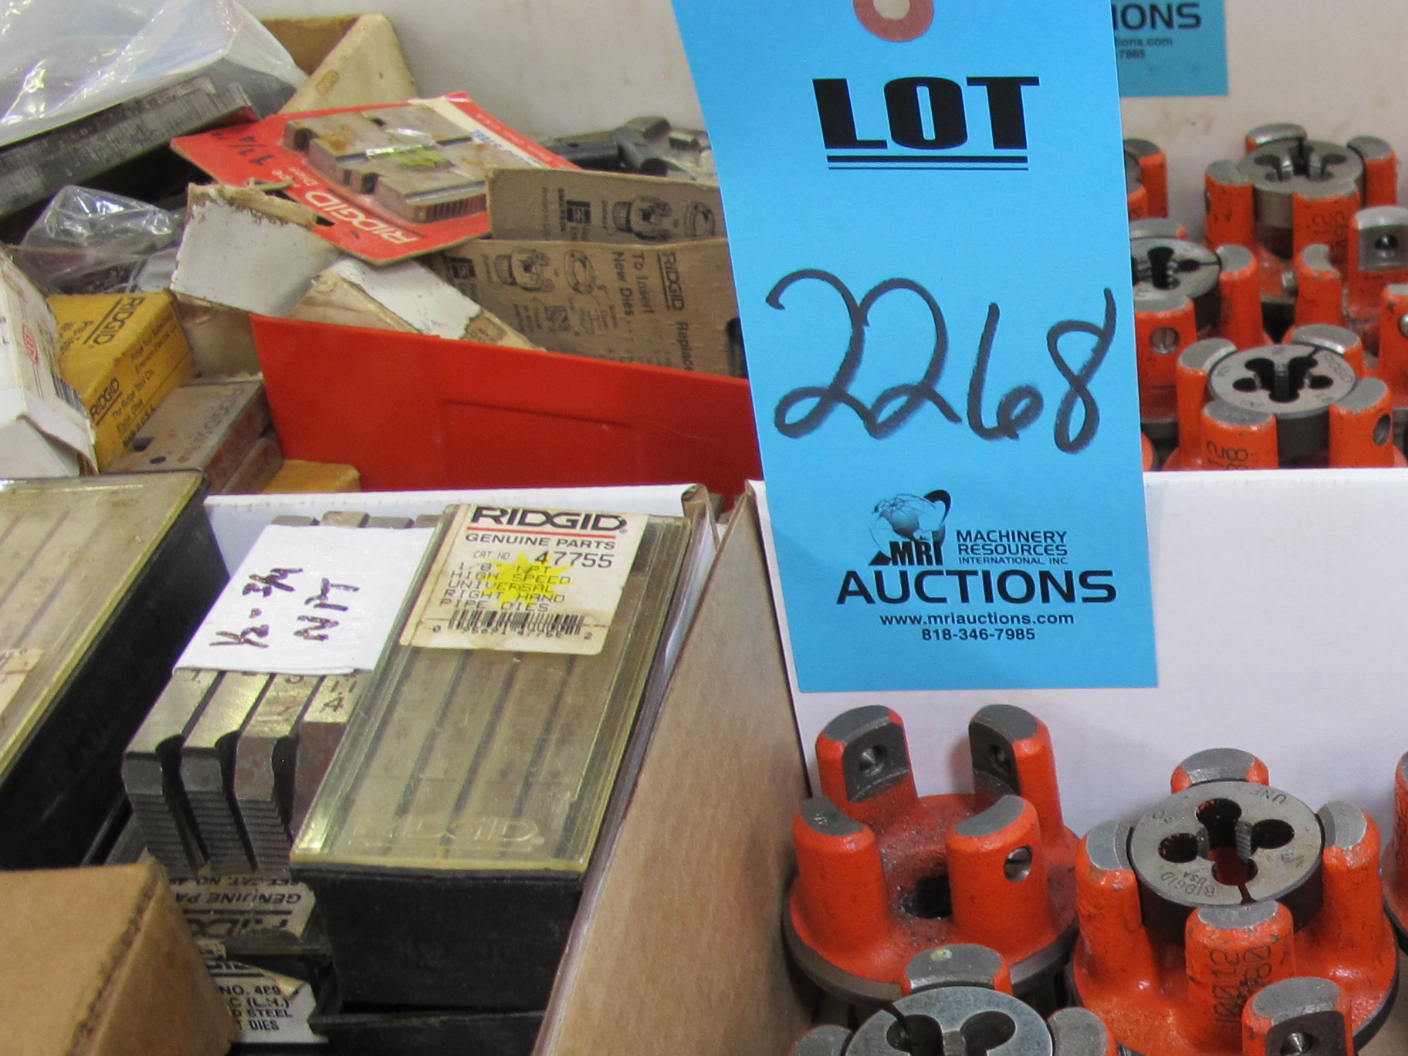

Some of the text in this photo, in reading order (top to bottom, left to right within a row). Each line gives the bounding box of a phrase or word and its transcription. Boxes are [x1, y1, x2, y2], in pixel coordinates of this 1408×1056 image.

[812, 76, 1040, 150] LOT
[305, 190, 419, 245] RIDGID
[612, 251, 634, 317] New Dies
[631, 252, 655, 314] To Insert
[661, 251, 686, 312] RIDGID
[92, 296, 147, 346] RIDGID
[765, 267, 1117, 454] 2268
[90, 377, 121, 419] RIDGID
[470, 506, 627, 532] RIDGID
[465, 533, 616, 550] GENUINE PARTS
[956, 530, 1067, 543] MACHINERY
[889, 539, 944, 566] MRI
[958, 543, 1068, 556] RESOURCES
[473, 550, 493, 559] CAT
[534, 551, 616, 569] 47755
[448, 580, 552, 593] UNIVERSAL
[451, 570, 572, 584] HIGH SPEED
[836, 569, 1117, 604] AUCTIONS
[439, 599, 550, 613] PIPE DIES
[443, 589, 566, 604] RIGHT HAND
[880, 612, 1074, 625] www.mriauctions.com
[922, 628, 1035, 641] 818-346-7985
[1160, 871, 1216, 898] RIDGID
[210, 892, 301, 905] GENUINE
[248, 1008, 293, 1018] STEEL
[250, 1020, 280, 1031] DIES
